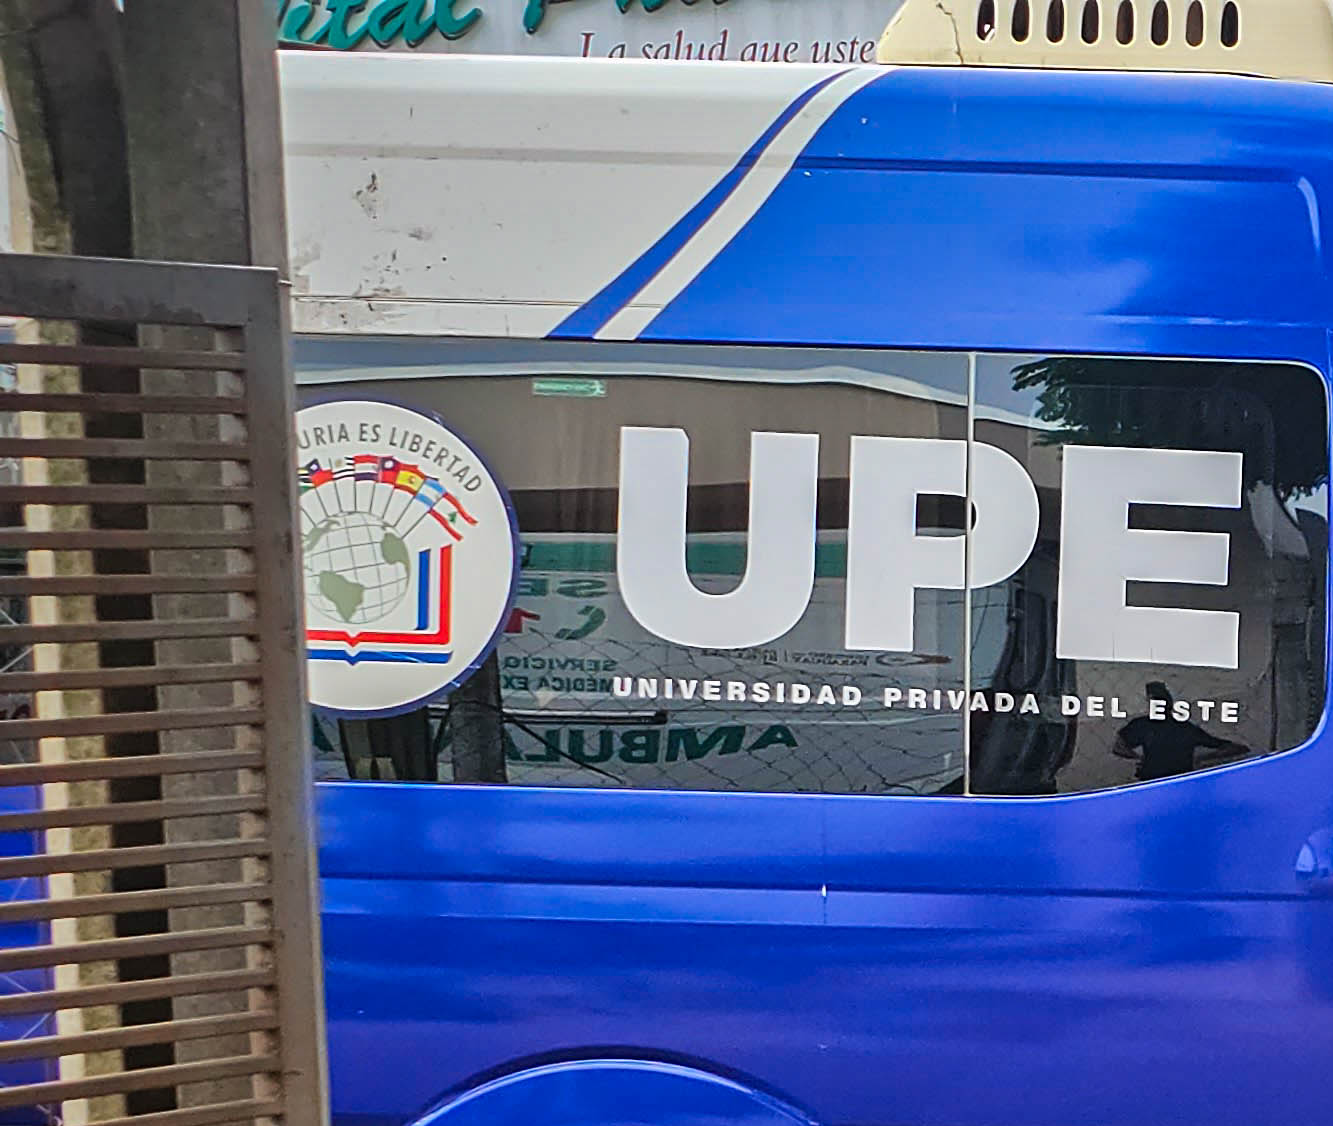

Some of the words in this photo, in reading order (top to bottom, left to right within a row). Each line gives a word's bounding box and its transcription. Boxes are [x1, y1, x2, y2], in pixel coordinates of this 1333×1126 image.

[641, 29, 729, 61] salud
[359, 423, 381, 442] ES
[389, 427, 482, 492] LIBERTAD
[617, 426, 1243, 669] UPE
[612, 676, 863, 707] UNIVERSIDAD
[884, 687, 1040, 715] PRIVADA
[1061, 696, 1128, 719] DEL
[1149, 700, 1240, 723] ESTE
